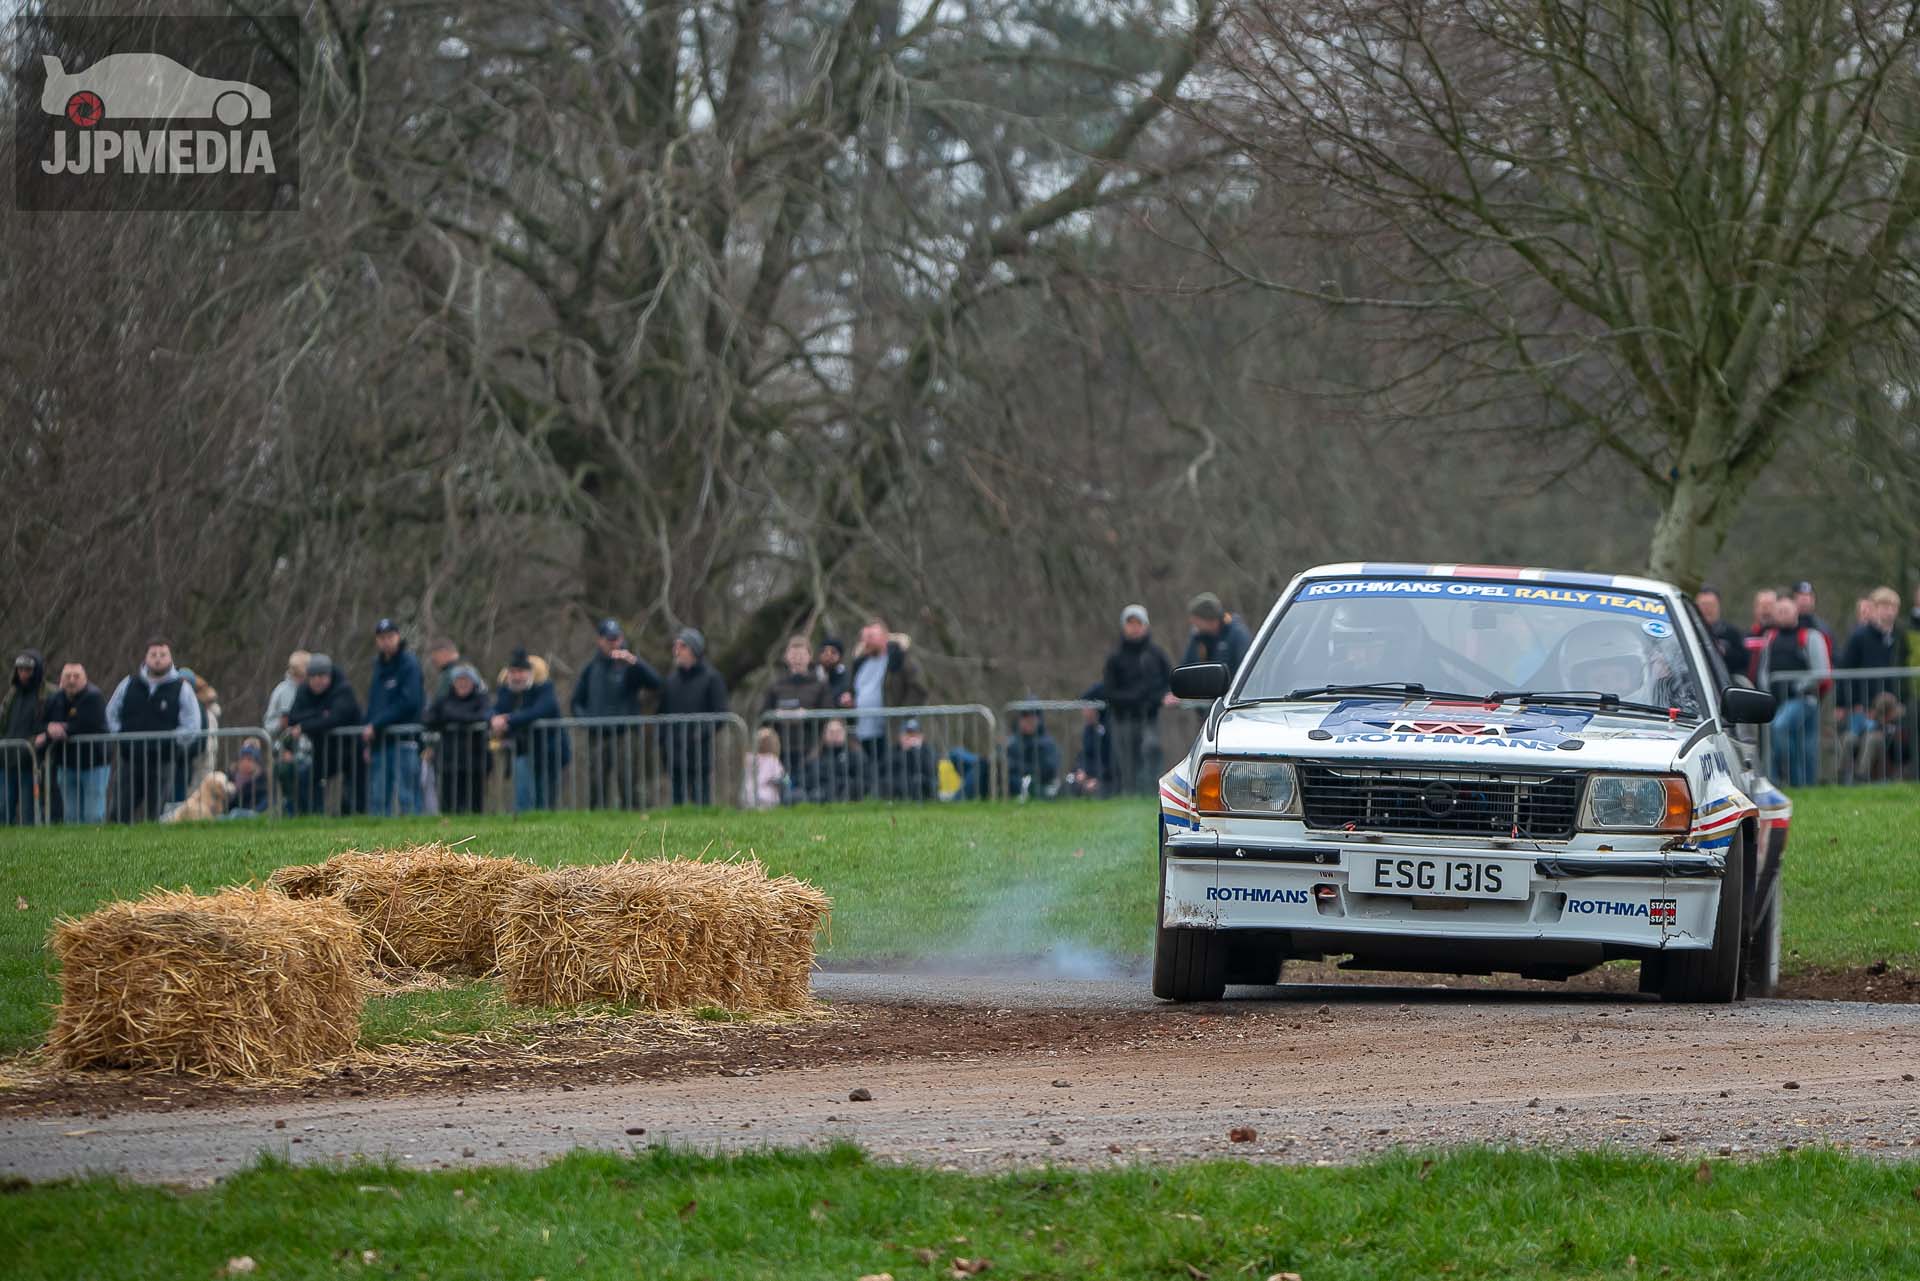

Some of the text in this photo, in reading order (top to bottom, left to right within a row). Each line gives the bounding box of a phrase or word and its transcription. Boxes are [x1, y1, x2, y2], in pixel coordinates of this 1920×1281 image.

[1308, 582, 1667, 615] ROTHMANS OPEL RALLY TEAM
[1335, 733, 1556, 752] ROTHMANS
[1374, 858, 1503, 893] ESG 131S
[1206, 886, 1308, 904] ROTHMANS
[1568, 899, 1650, 917] ROTHMA
[1650, 915, 1676, 923] STACK
